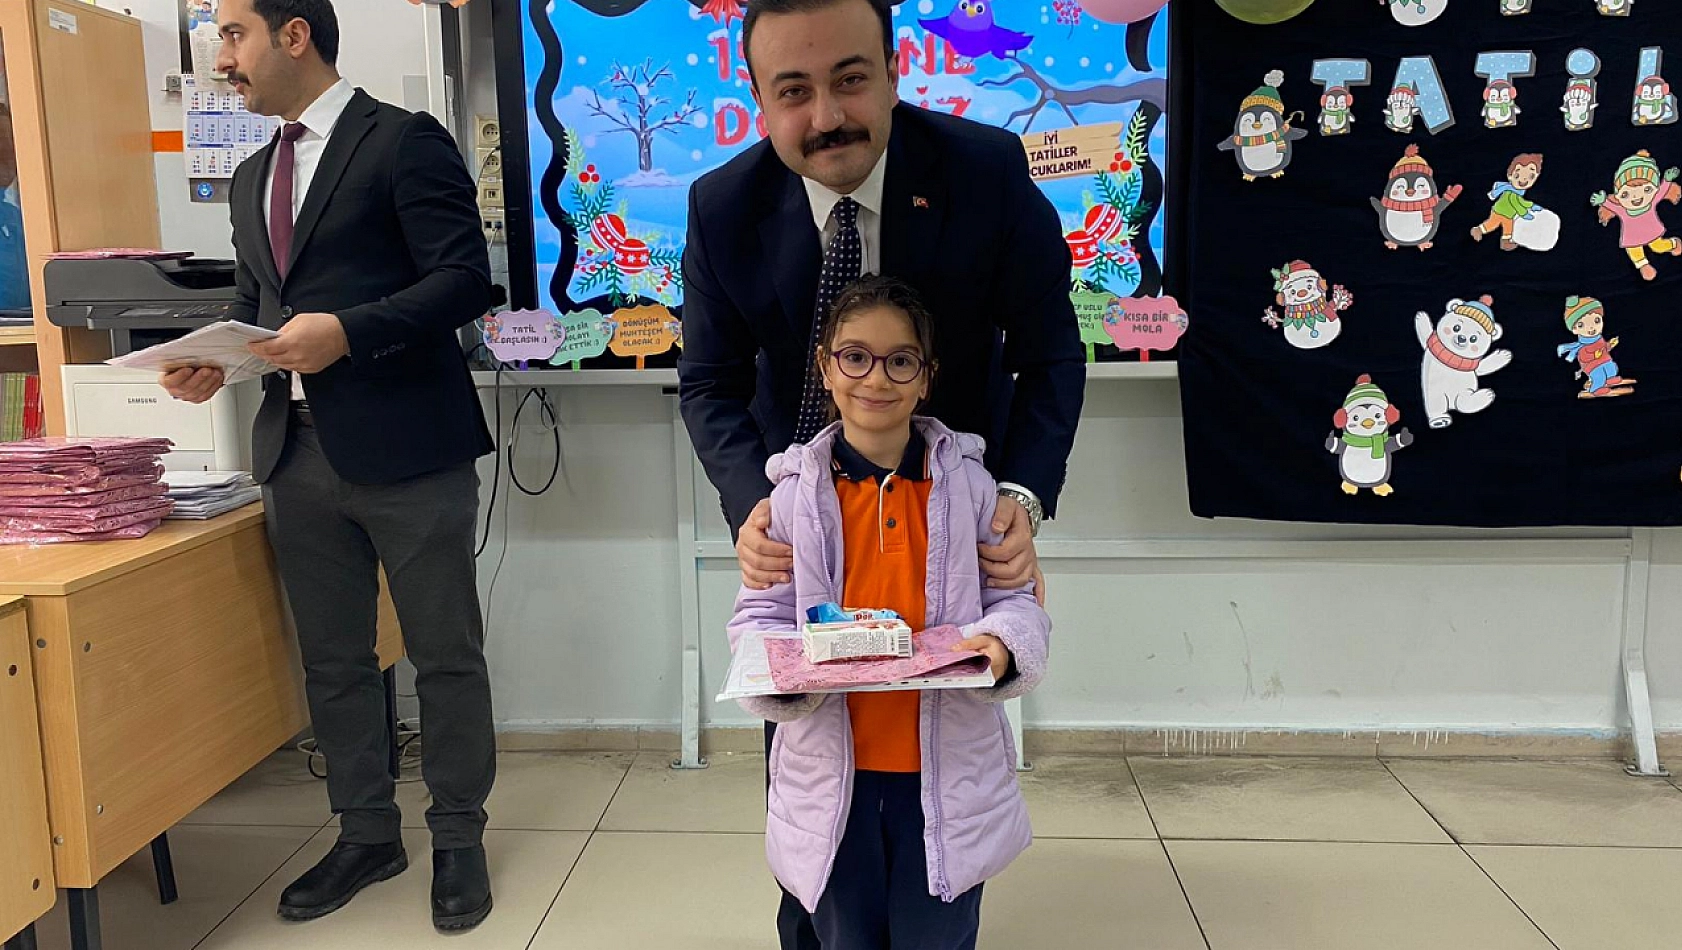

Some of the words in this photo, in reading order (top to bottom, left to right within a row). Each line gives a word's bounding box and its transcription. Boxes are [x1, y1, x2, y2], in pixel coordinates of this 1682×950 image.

[1044, 130, 1058, 146] İYİ
[1029, 145, 1078, 162] TATİLLER
[1030, 158, 1091, 177] CUKLARIM!
[1124, 313, 1148, 322] KISA
[1152, 310, 1169, 322] BİR
[512, 324, 536, 333] TATİL
[1132, 325, 1162, 333] MOLA
[501, 336, 539, 346] BAŞLASIN
